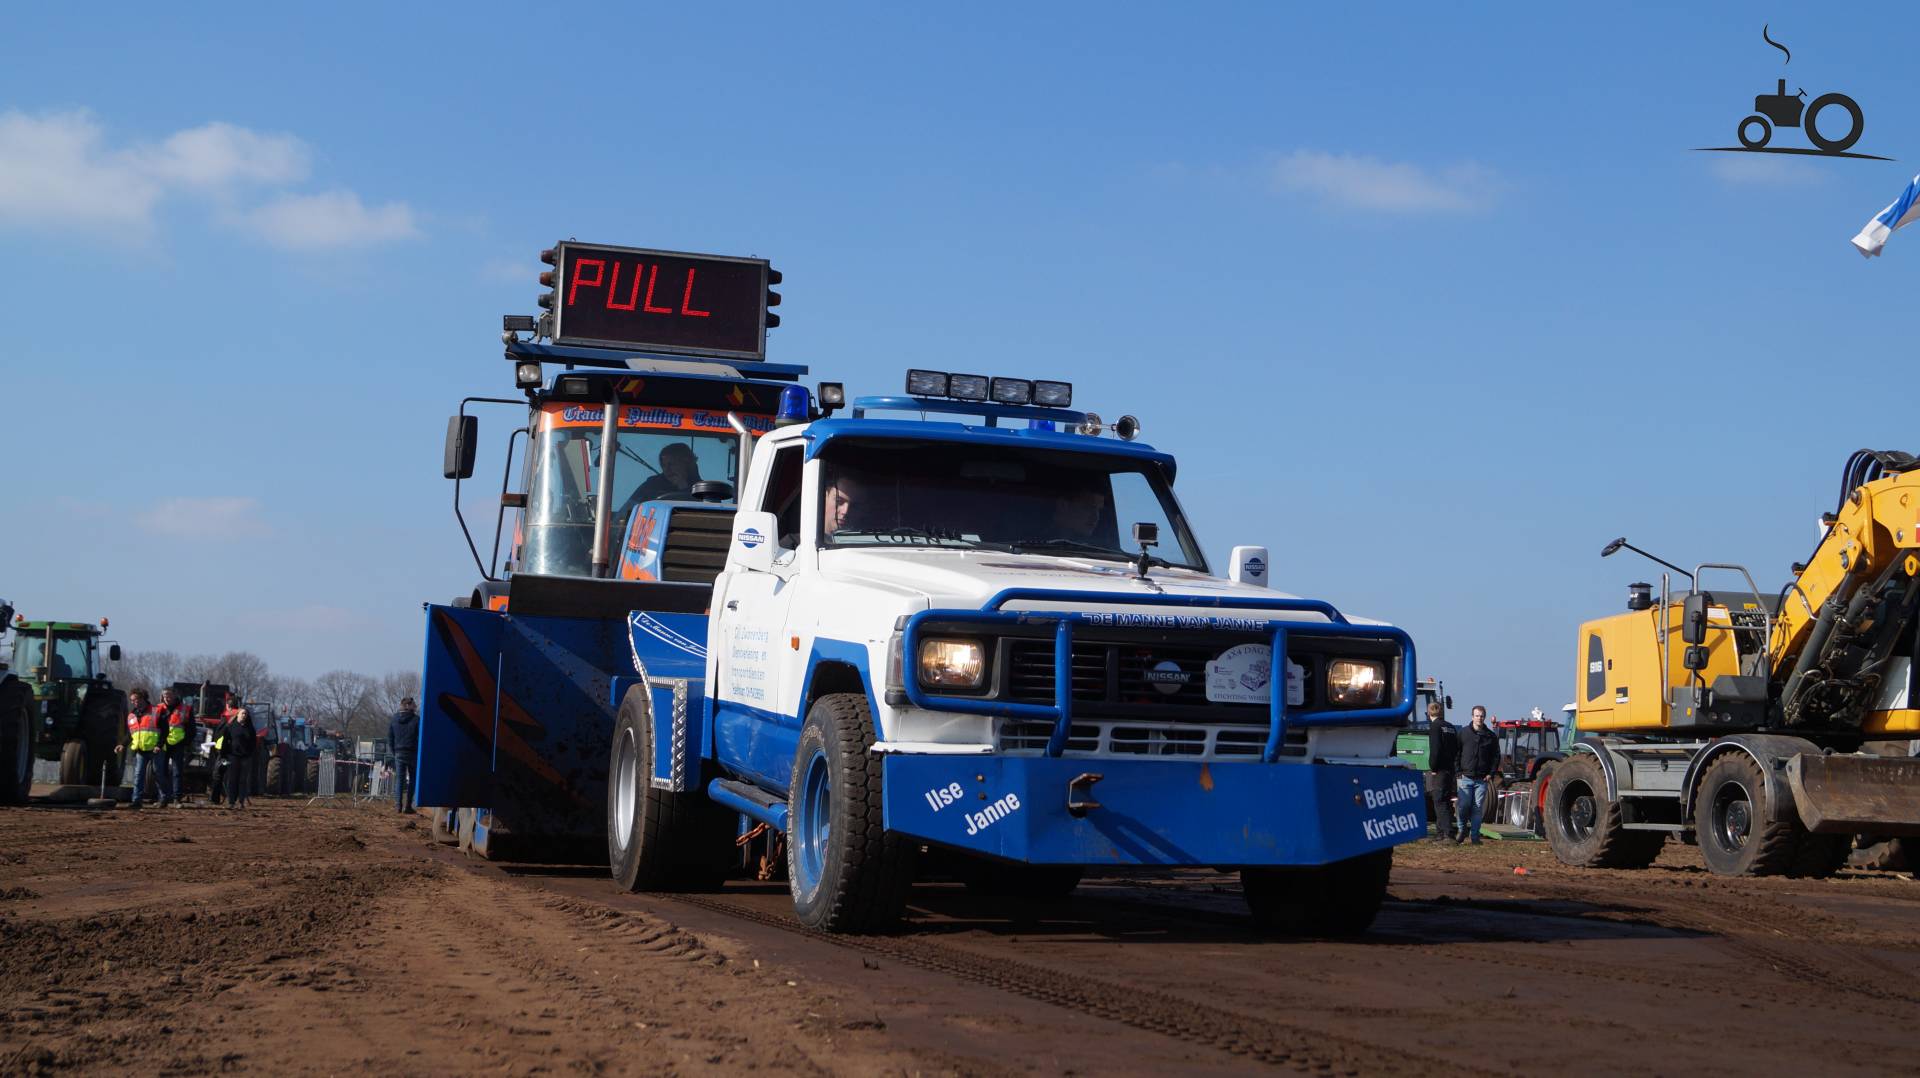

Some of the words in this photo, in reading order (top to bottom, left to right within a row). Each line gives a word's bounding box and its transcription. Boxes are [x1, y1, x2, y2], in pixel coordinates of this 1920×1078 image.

[567, 258, 711, 317] PULL
[624, 407, 684, 427] Pulling
[739, 534, 764, 543] NISSAN
[1084, 612, 1113, 626] DE
[1115, 612, 1176, 628] MANNE
[1176, 615, 1209, 629] VAN
[1215, 617, 1265, 631] JANNE
[1146, 671, 1190, 683] NISSAN
[925, 782, 964, 812] Ilse
[1363, 781, 1419, 809] Benthe
[964, 793, 1021, 836] Janne
[1362, 812, 1419, 841] Kirsten
